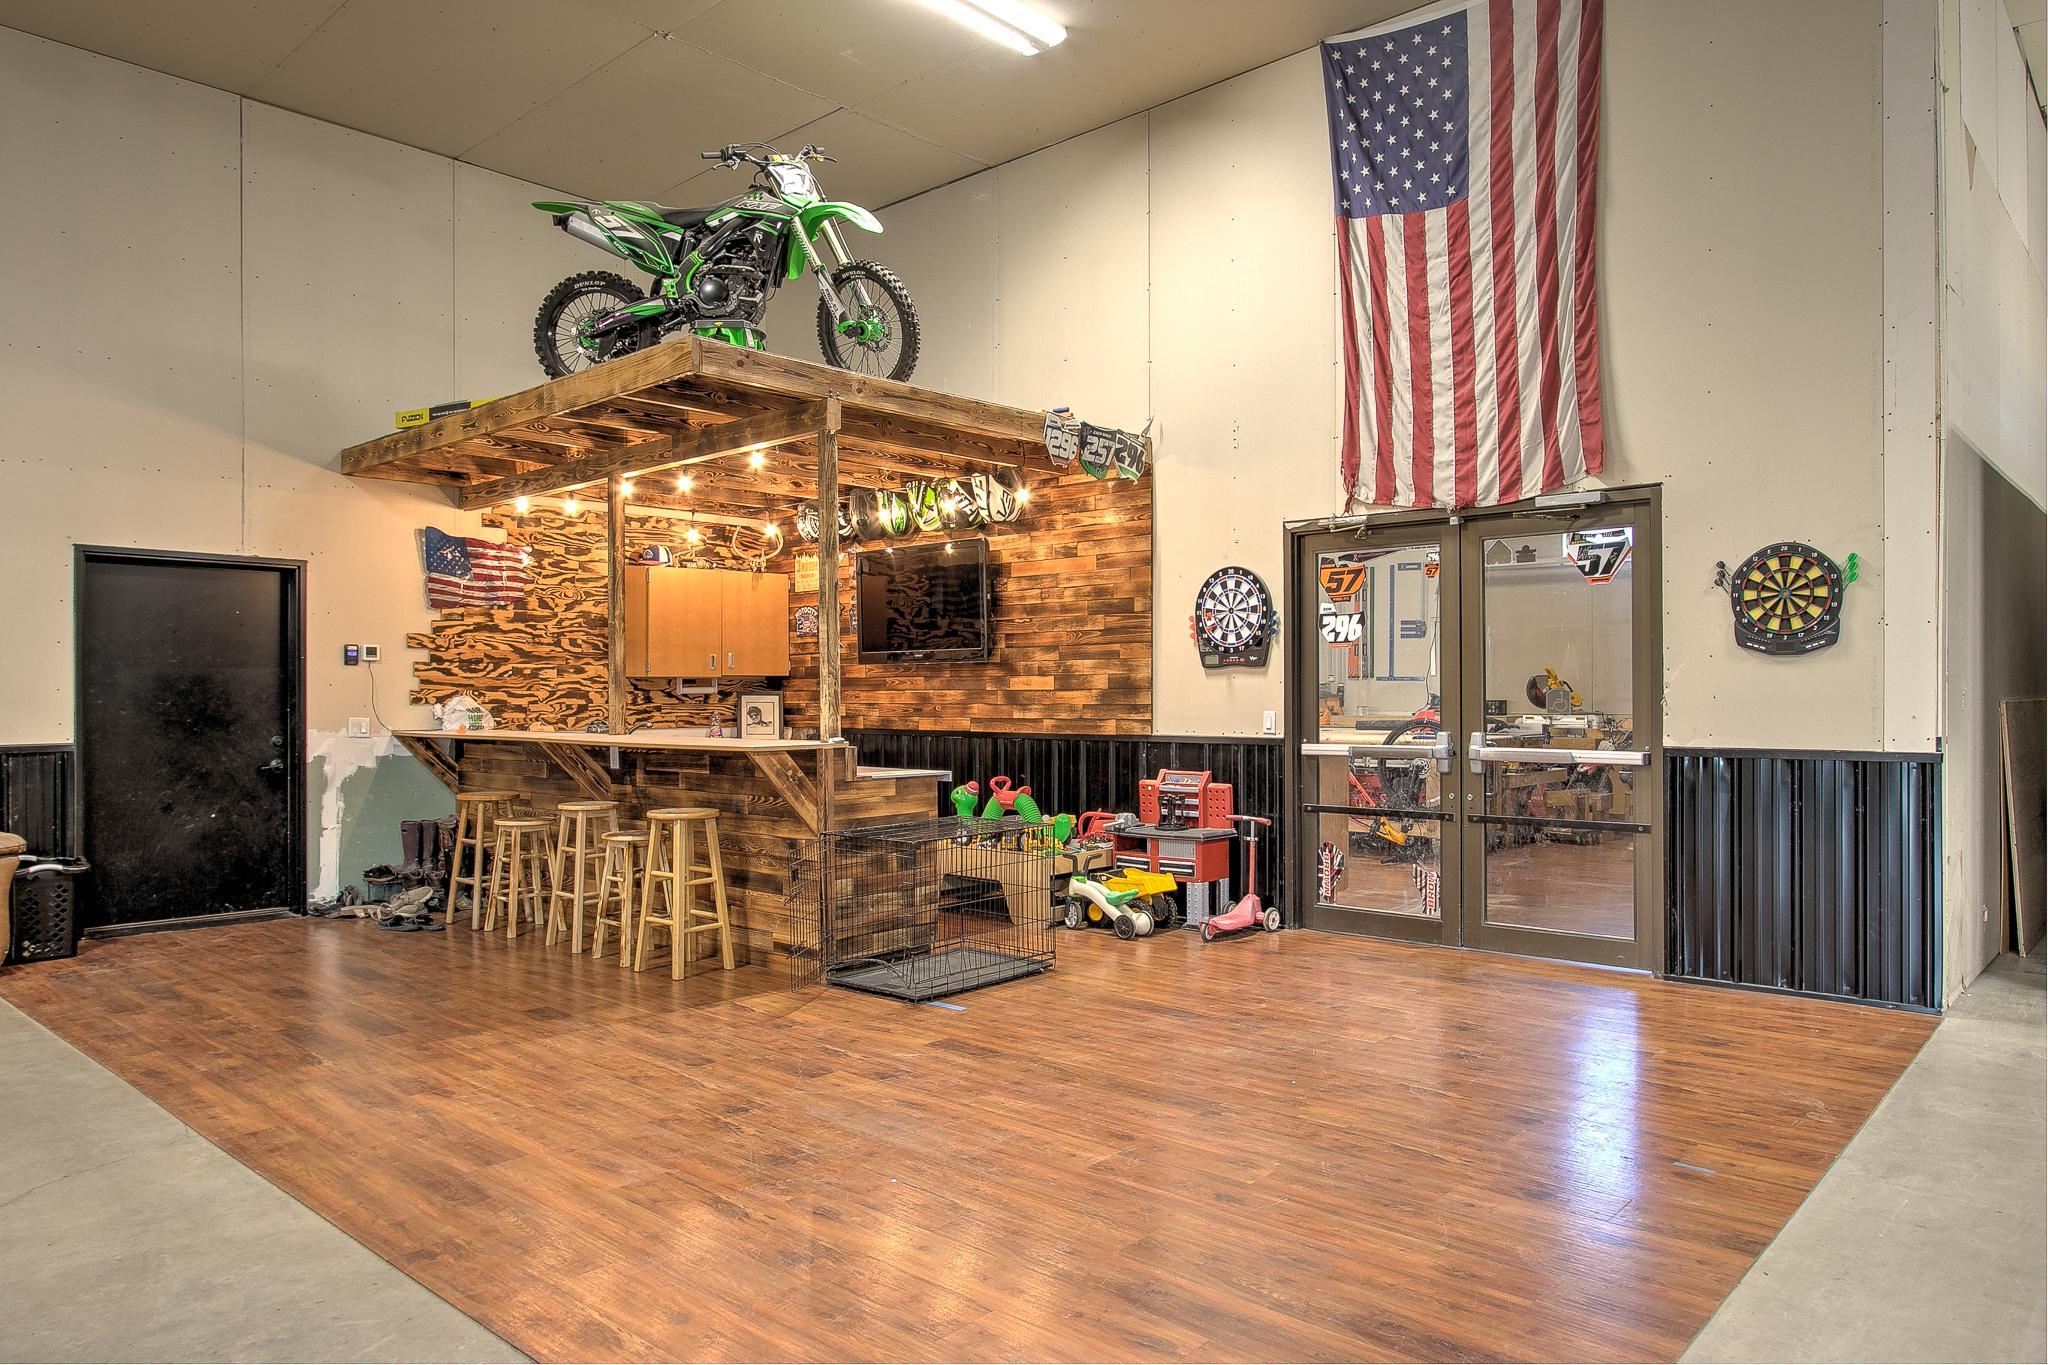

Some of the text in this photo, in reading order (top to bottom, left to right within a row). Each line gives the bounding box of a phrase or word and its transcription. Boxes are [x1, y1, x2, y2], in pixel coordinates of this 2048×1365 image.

[1116, 436, 1144, 472] 296
[1426, 567, 1438, 576] 57
[1576, 542, 1626, 576] 57
[1325, 568, 1364, 594] 57
[1321, 614, 1362, 642] 296
